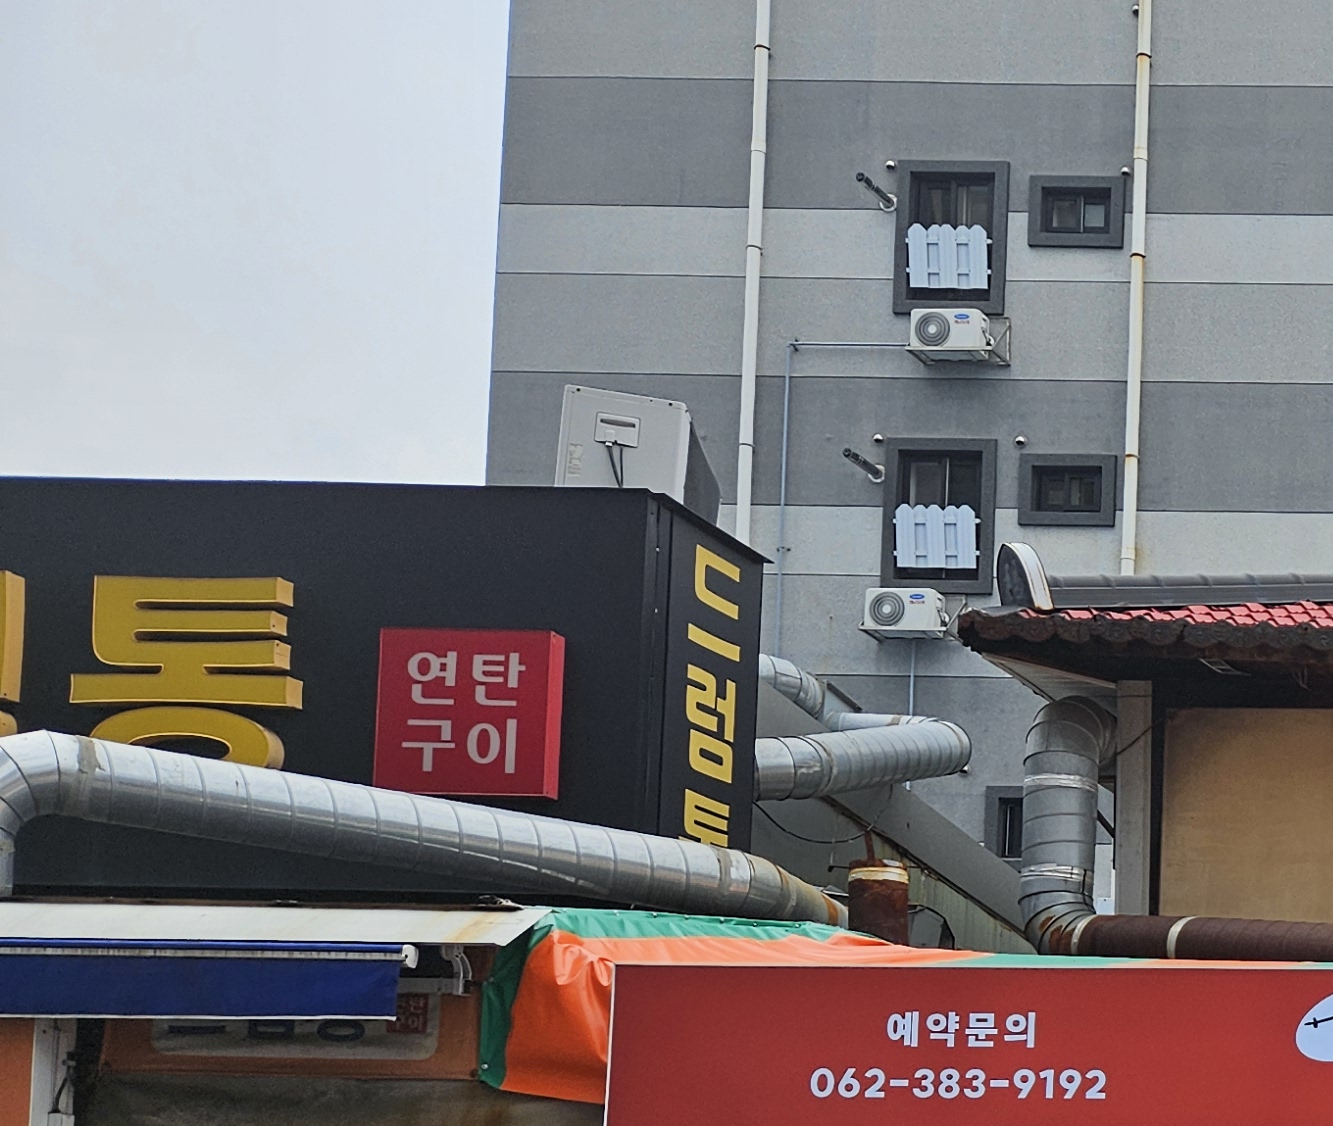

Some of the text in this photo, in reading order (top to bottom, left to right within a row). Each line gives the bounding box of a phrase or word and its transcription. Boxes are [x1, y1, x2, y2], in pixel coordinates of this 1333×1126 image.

[408, 651, 526, 706] 연탄
[402, 718, 517, 774] 구이
[886, 1011, 1036, 1048] 예약문의
[810, 1067, 1107, 1100] 062-383-9192
